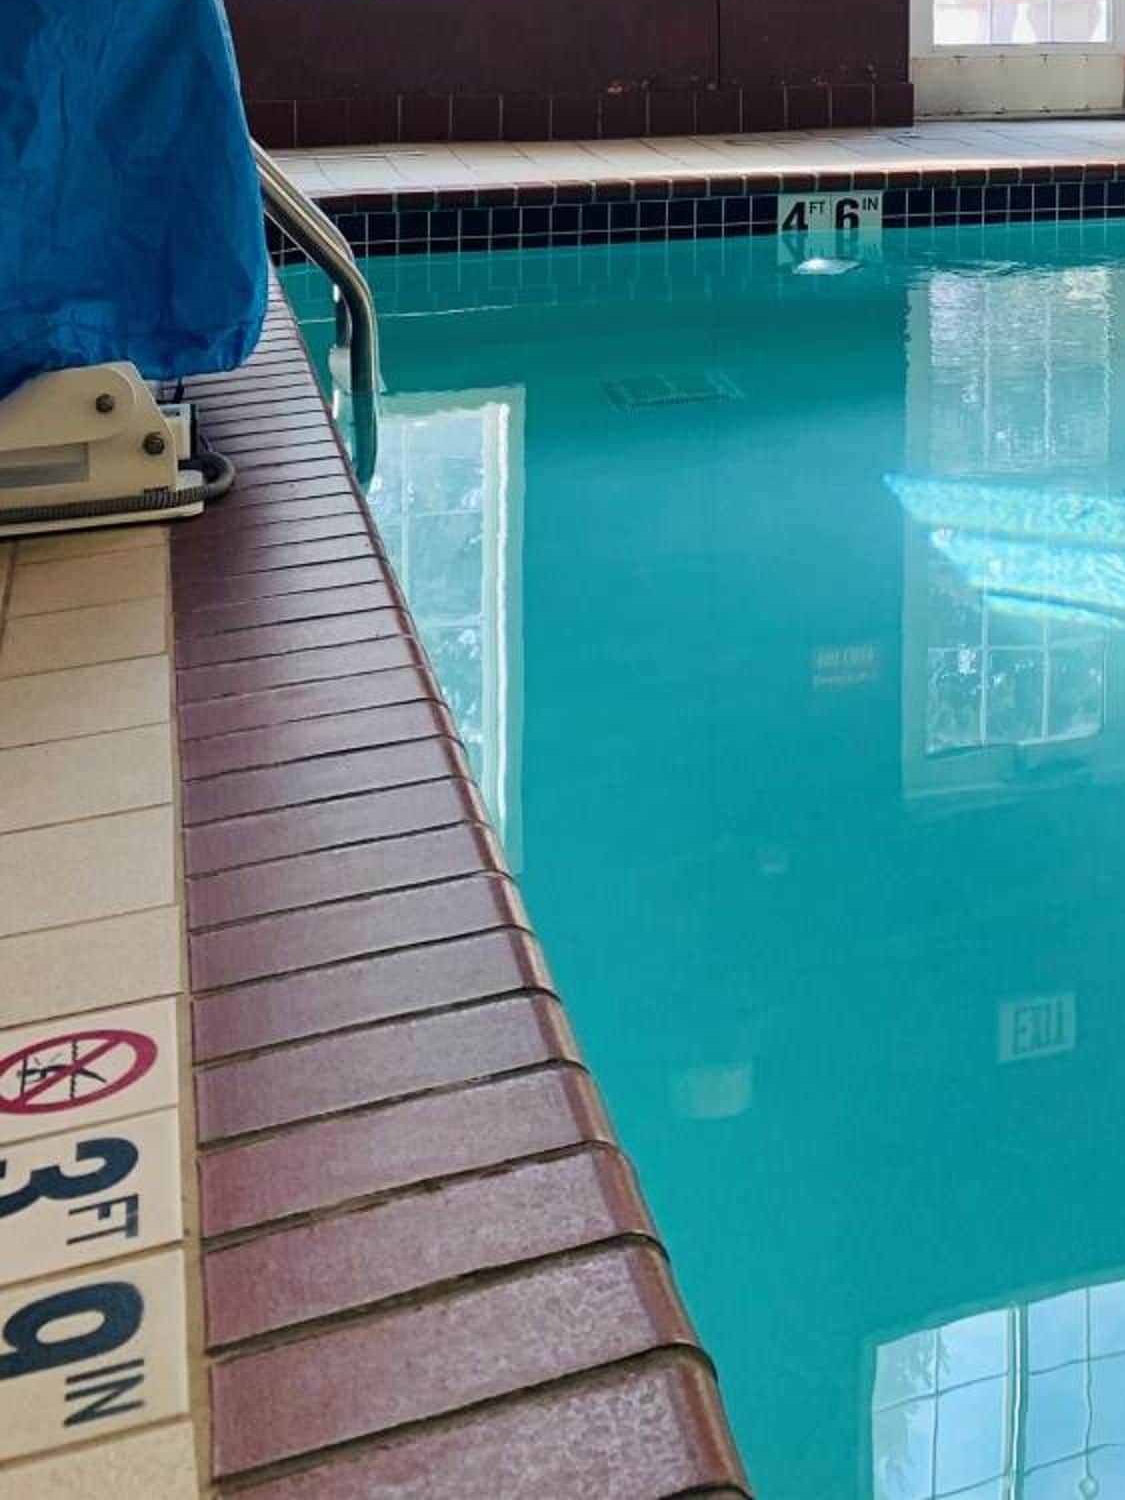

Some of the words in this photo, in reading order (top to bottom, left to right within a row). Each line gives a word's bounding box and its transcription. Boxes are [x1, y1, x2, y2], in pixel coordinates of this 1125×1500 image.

[782, 201, 808, 232] 4
[809, 201, 826, 215] FT
[835, 197, 860, 229] 6
[862, 197, 880, 211] IN
[0, 1137, 139, 1218] 3
[66, 1193, 139, 1246] FT
[0, 1281, 142, 1381] 9
[62, 1358, 145, 1428] IN
